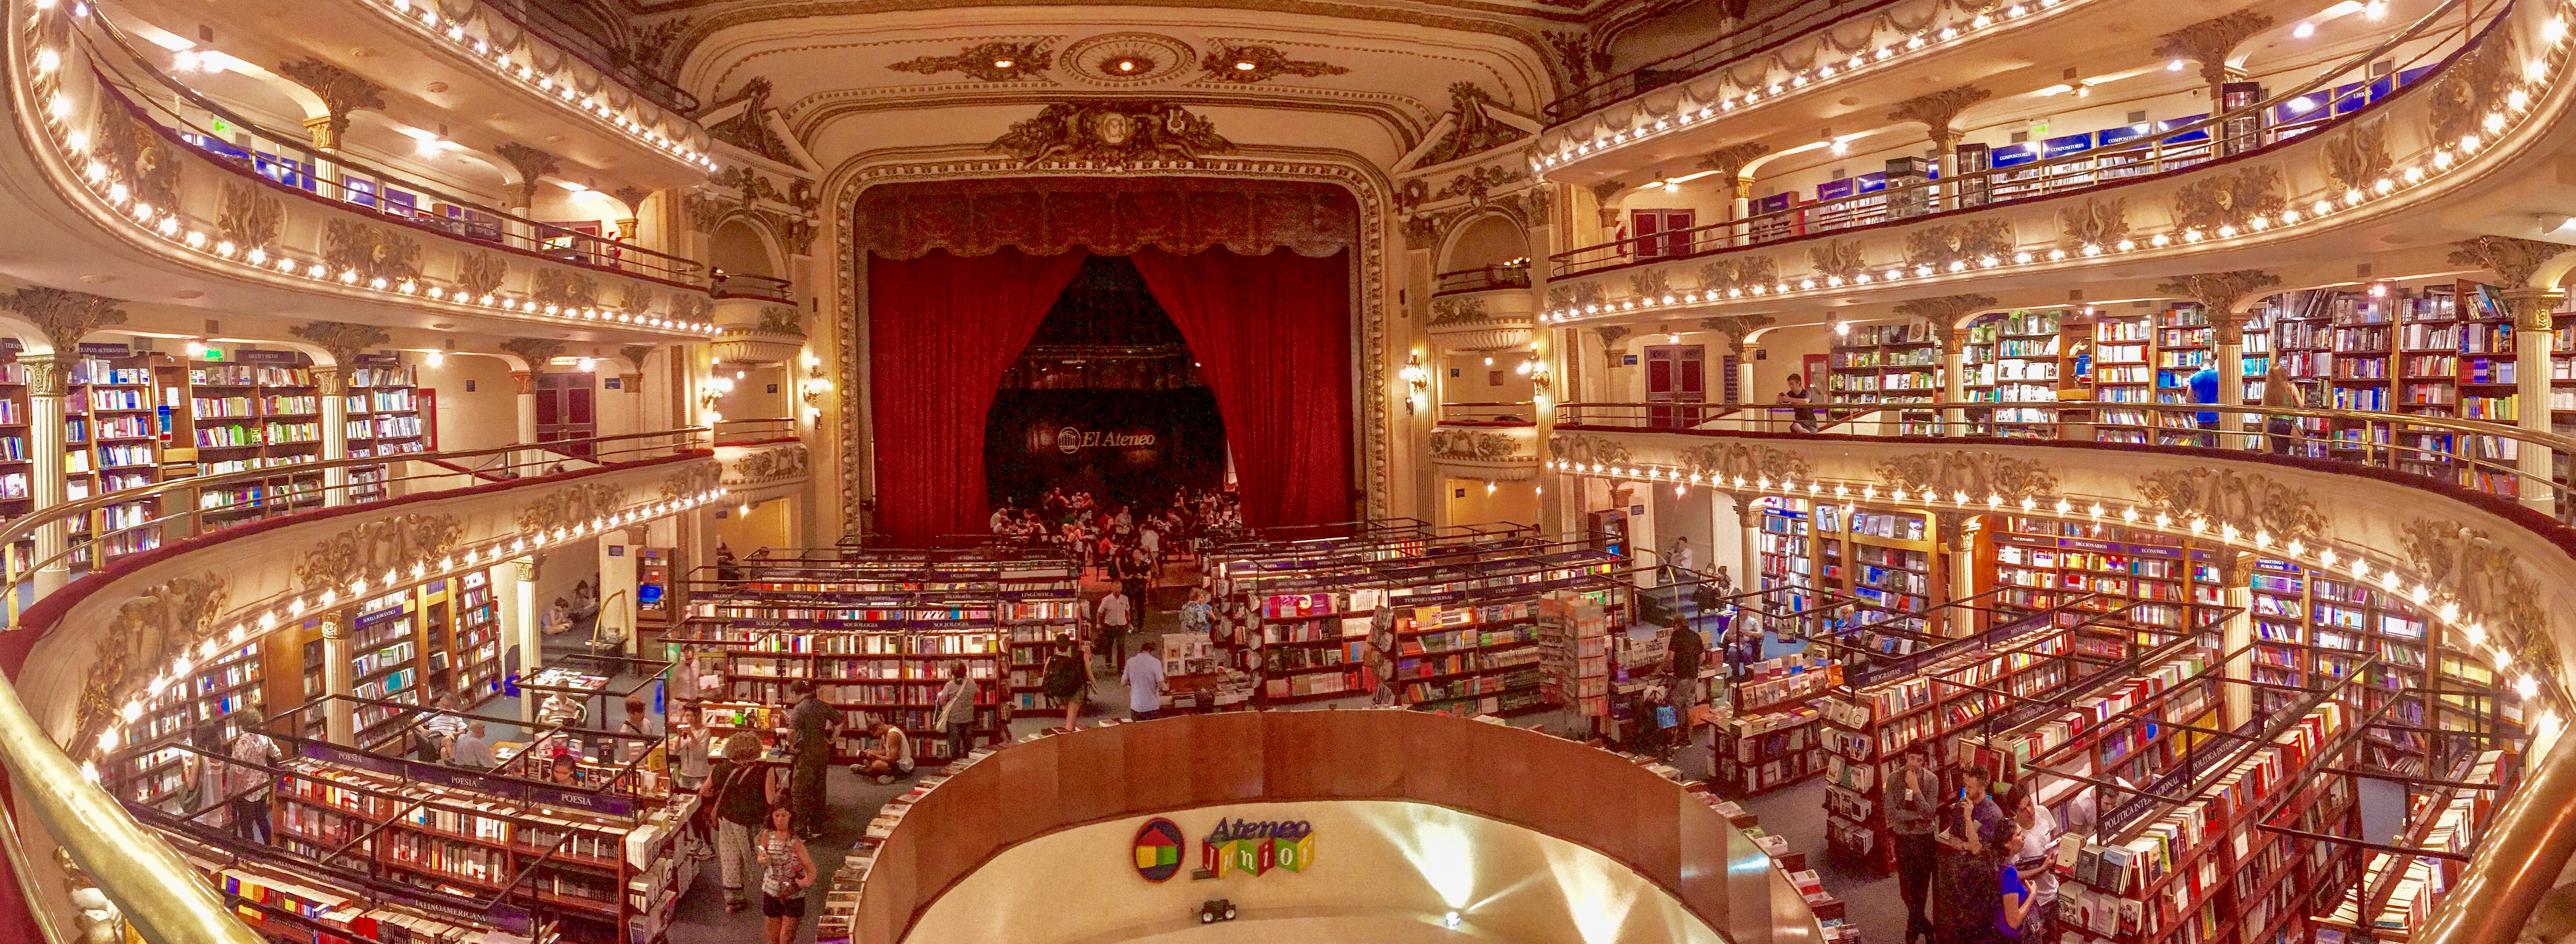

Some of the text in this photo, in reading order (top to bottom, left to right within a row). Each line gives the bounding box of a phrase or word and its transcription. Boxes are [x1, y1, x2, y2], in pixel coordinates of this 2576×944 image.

[2108, 135, 2143, 143] COMPOSITORES
[2051, 143, 2084, 152] COMPOSITORES
[2000, 152, 2031, 160] COMPOSITORES
[1081, 431, 1155, 447] El Ateneo
[363, 615, 376, 623] NOVELA
[2010, 624, 2030, 635] HISTORIA
[2104, 806, 2134, 830] POLITICA
[1209, 817, 1311, 842] Ateneo
[1205, 840, 1313, 871] Junior
